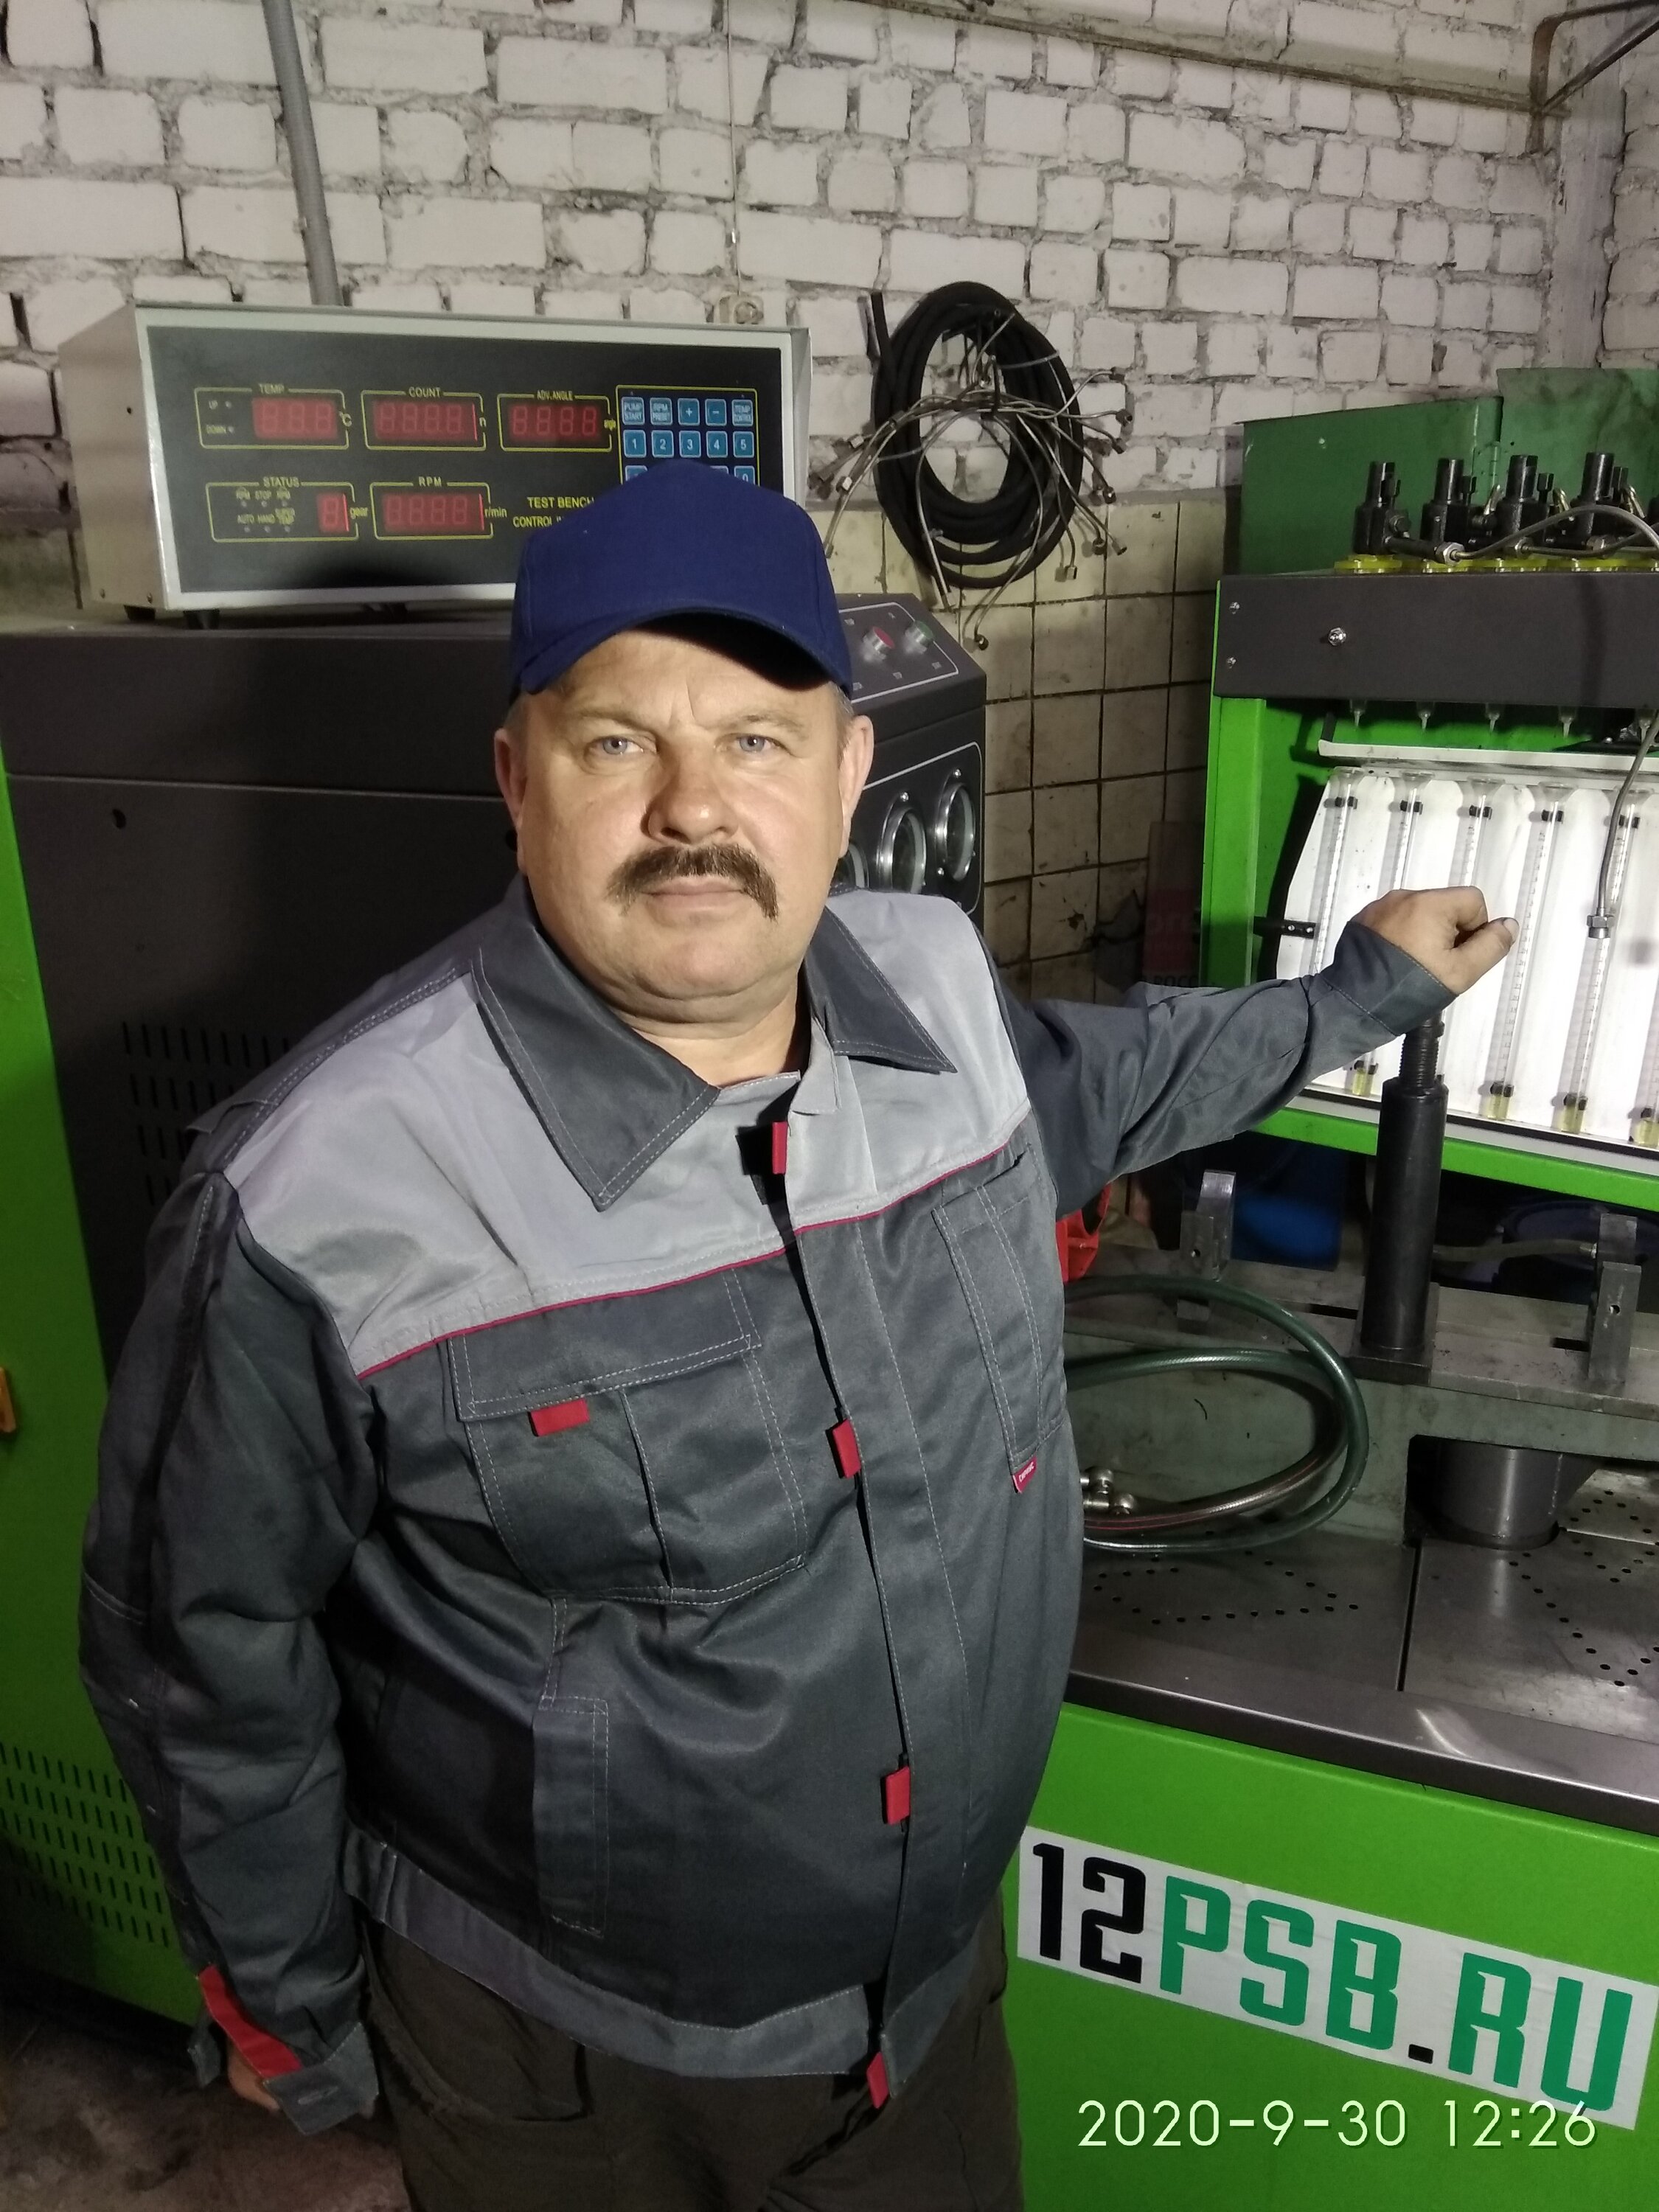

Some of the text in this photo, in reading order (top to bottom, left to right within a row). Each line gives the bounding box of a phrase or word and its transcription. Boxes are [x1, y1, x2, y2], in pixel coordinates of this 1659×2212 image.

[259, 383, 285, 394] TEMP
[408, 386, 441, 398] COUNT
[631, 438, 638, 450] 1
[659, 438, 667, 451] 2
[686, 439, 694, 451] 3
[713, 439, 720, 451] 4
[740, 439, 747, 451] 5
[262, 476, 300, 488] STATUS
[418, 476, 442, 487] RPM
[526, 496, 555, 509] TEST
[484, 506, 508, 518] r/min
[1032, 1843, 1633, 2112] 12PSB.RU
